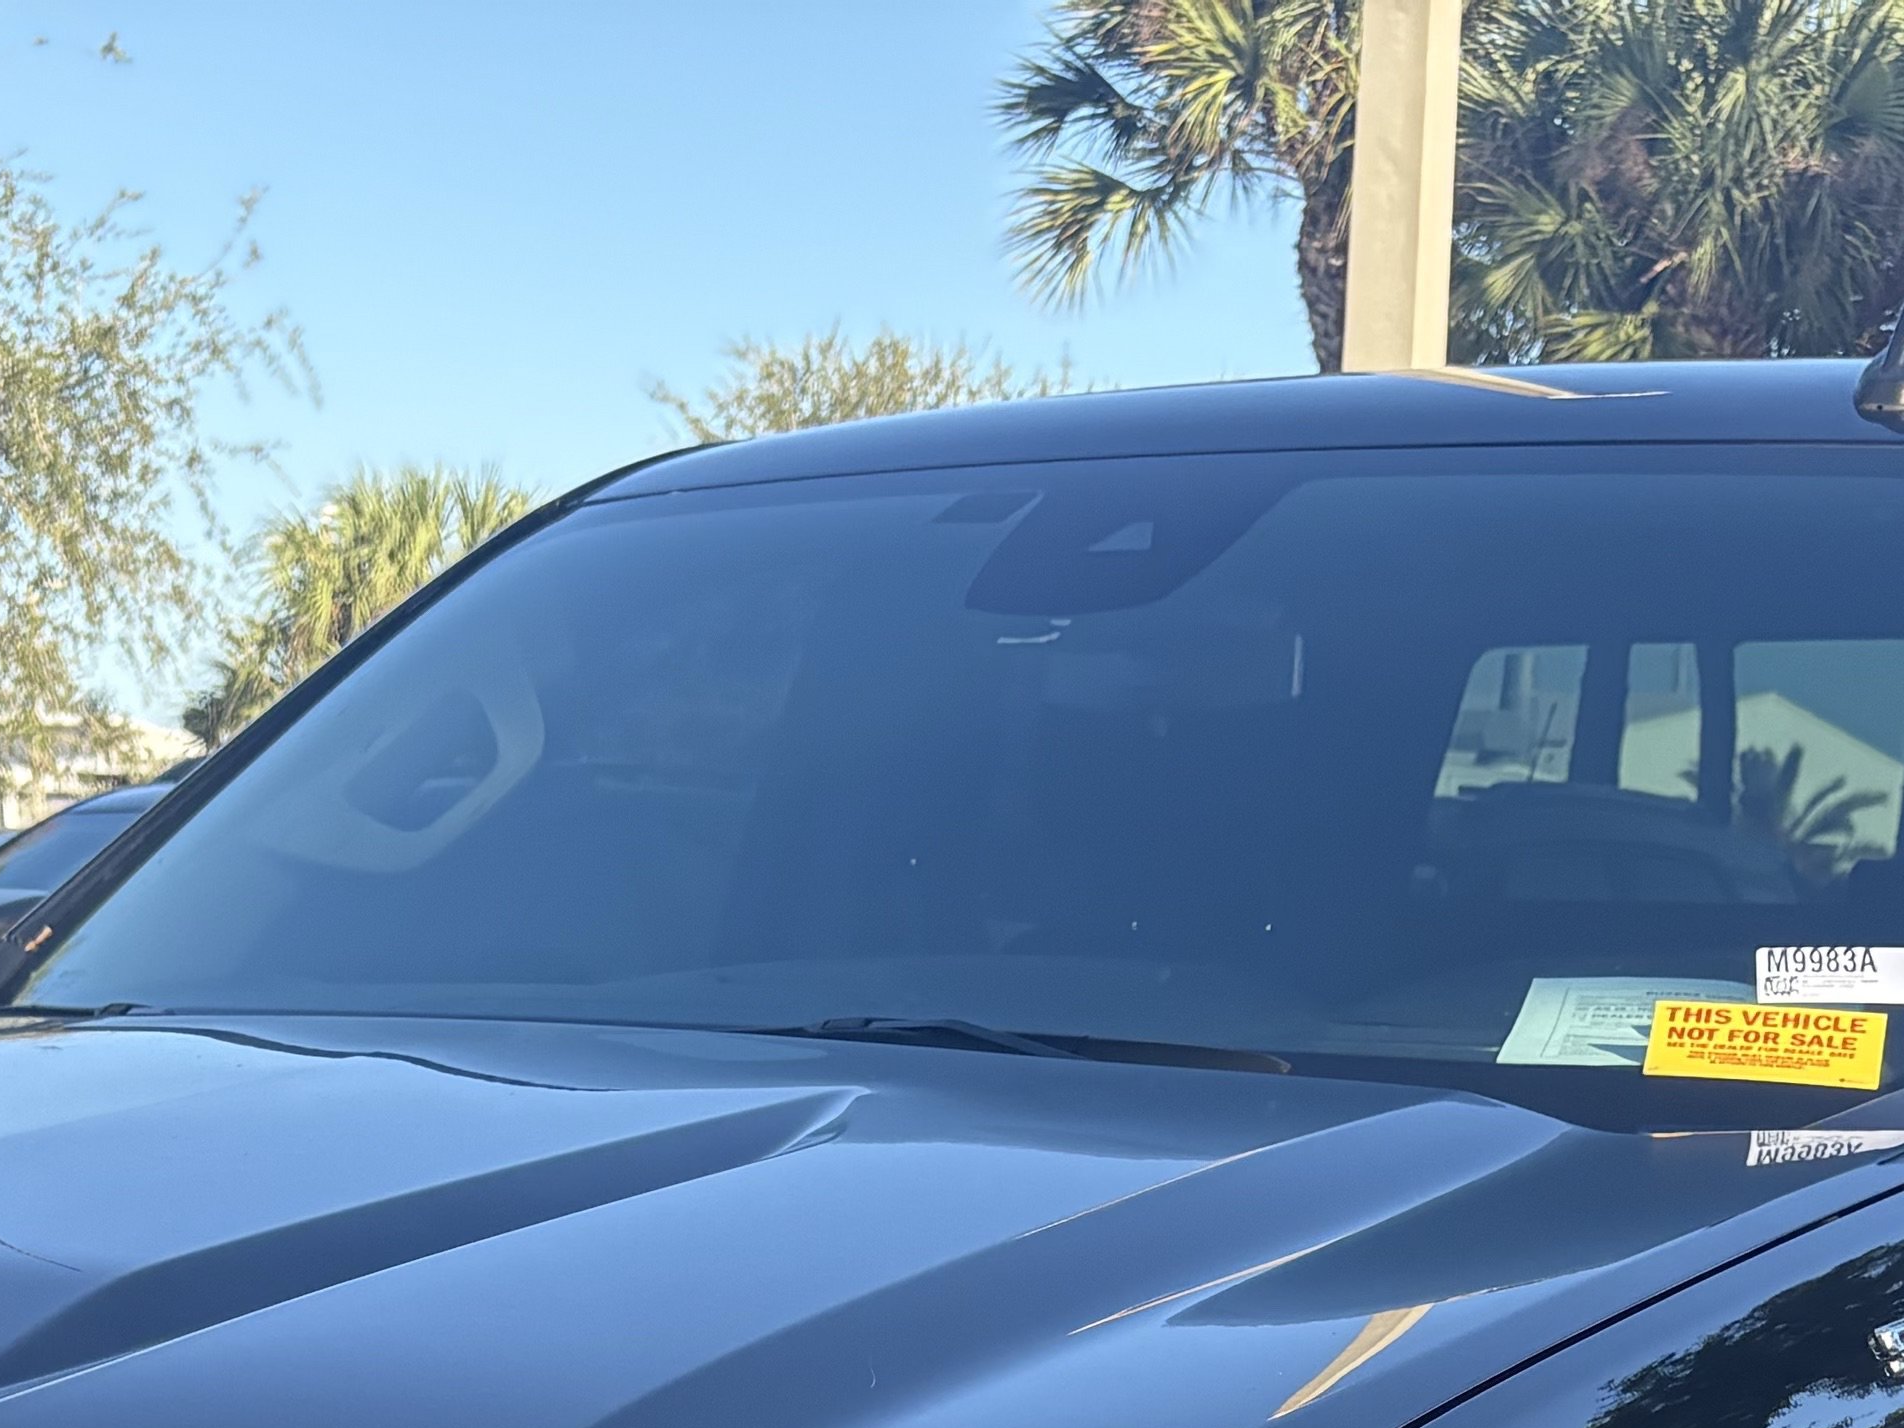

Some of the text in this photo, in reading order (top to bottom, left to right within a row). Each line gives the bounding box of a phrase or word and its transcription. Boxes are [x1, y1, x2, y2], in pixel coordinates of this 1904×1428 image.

[1767, 947, 1878, 973] M9983A
[1666, 1006, 1869, 1034] THIS VEHICLE
[1667, 1026, 1858, 1051] NOT FOR SALE
